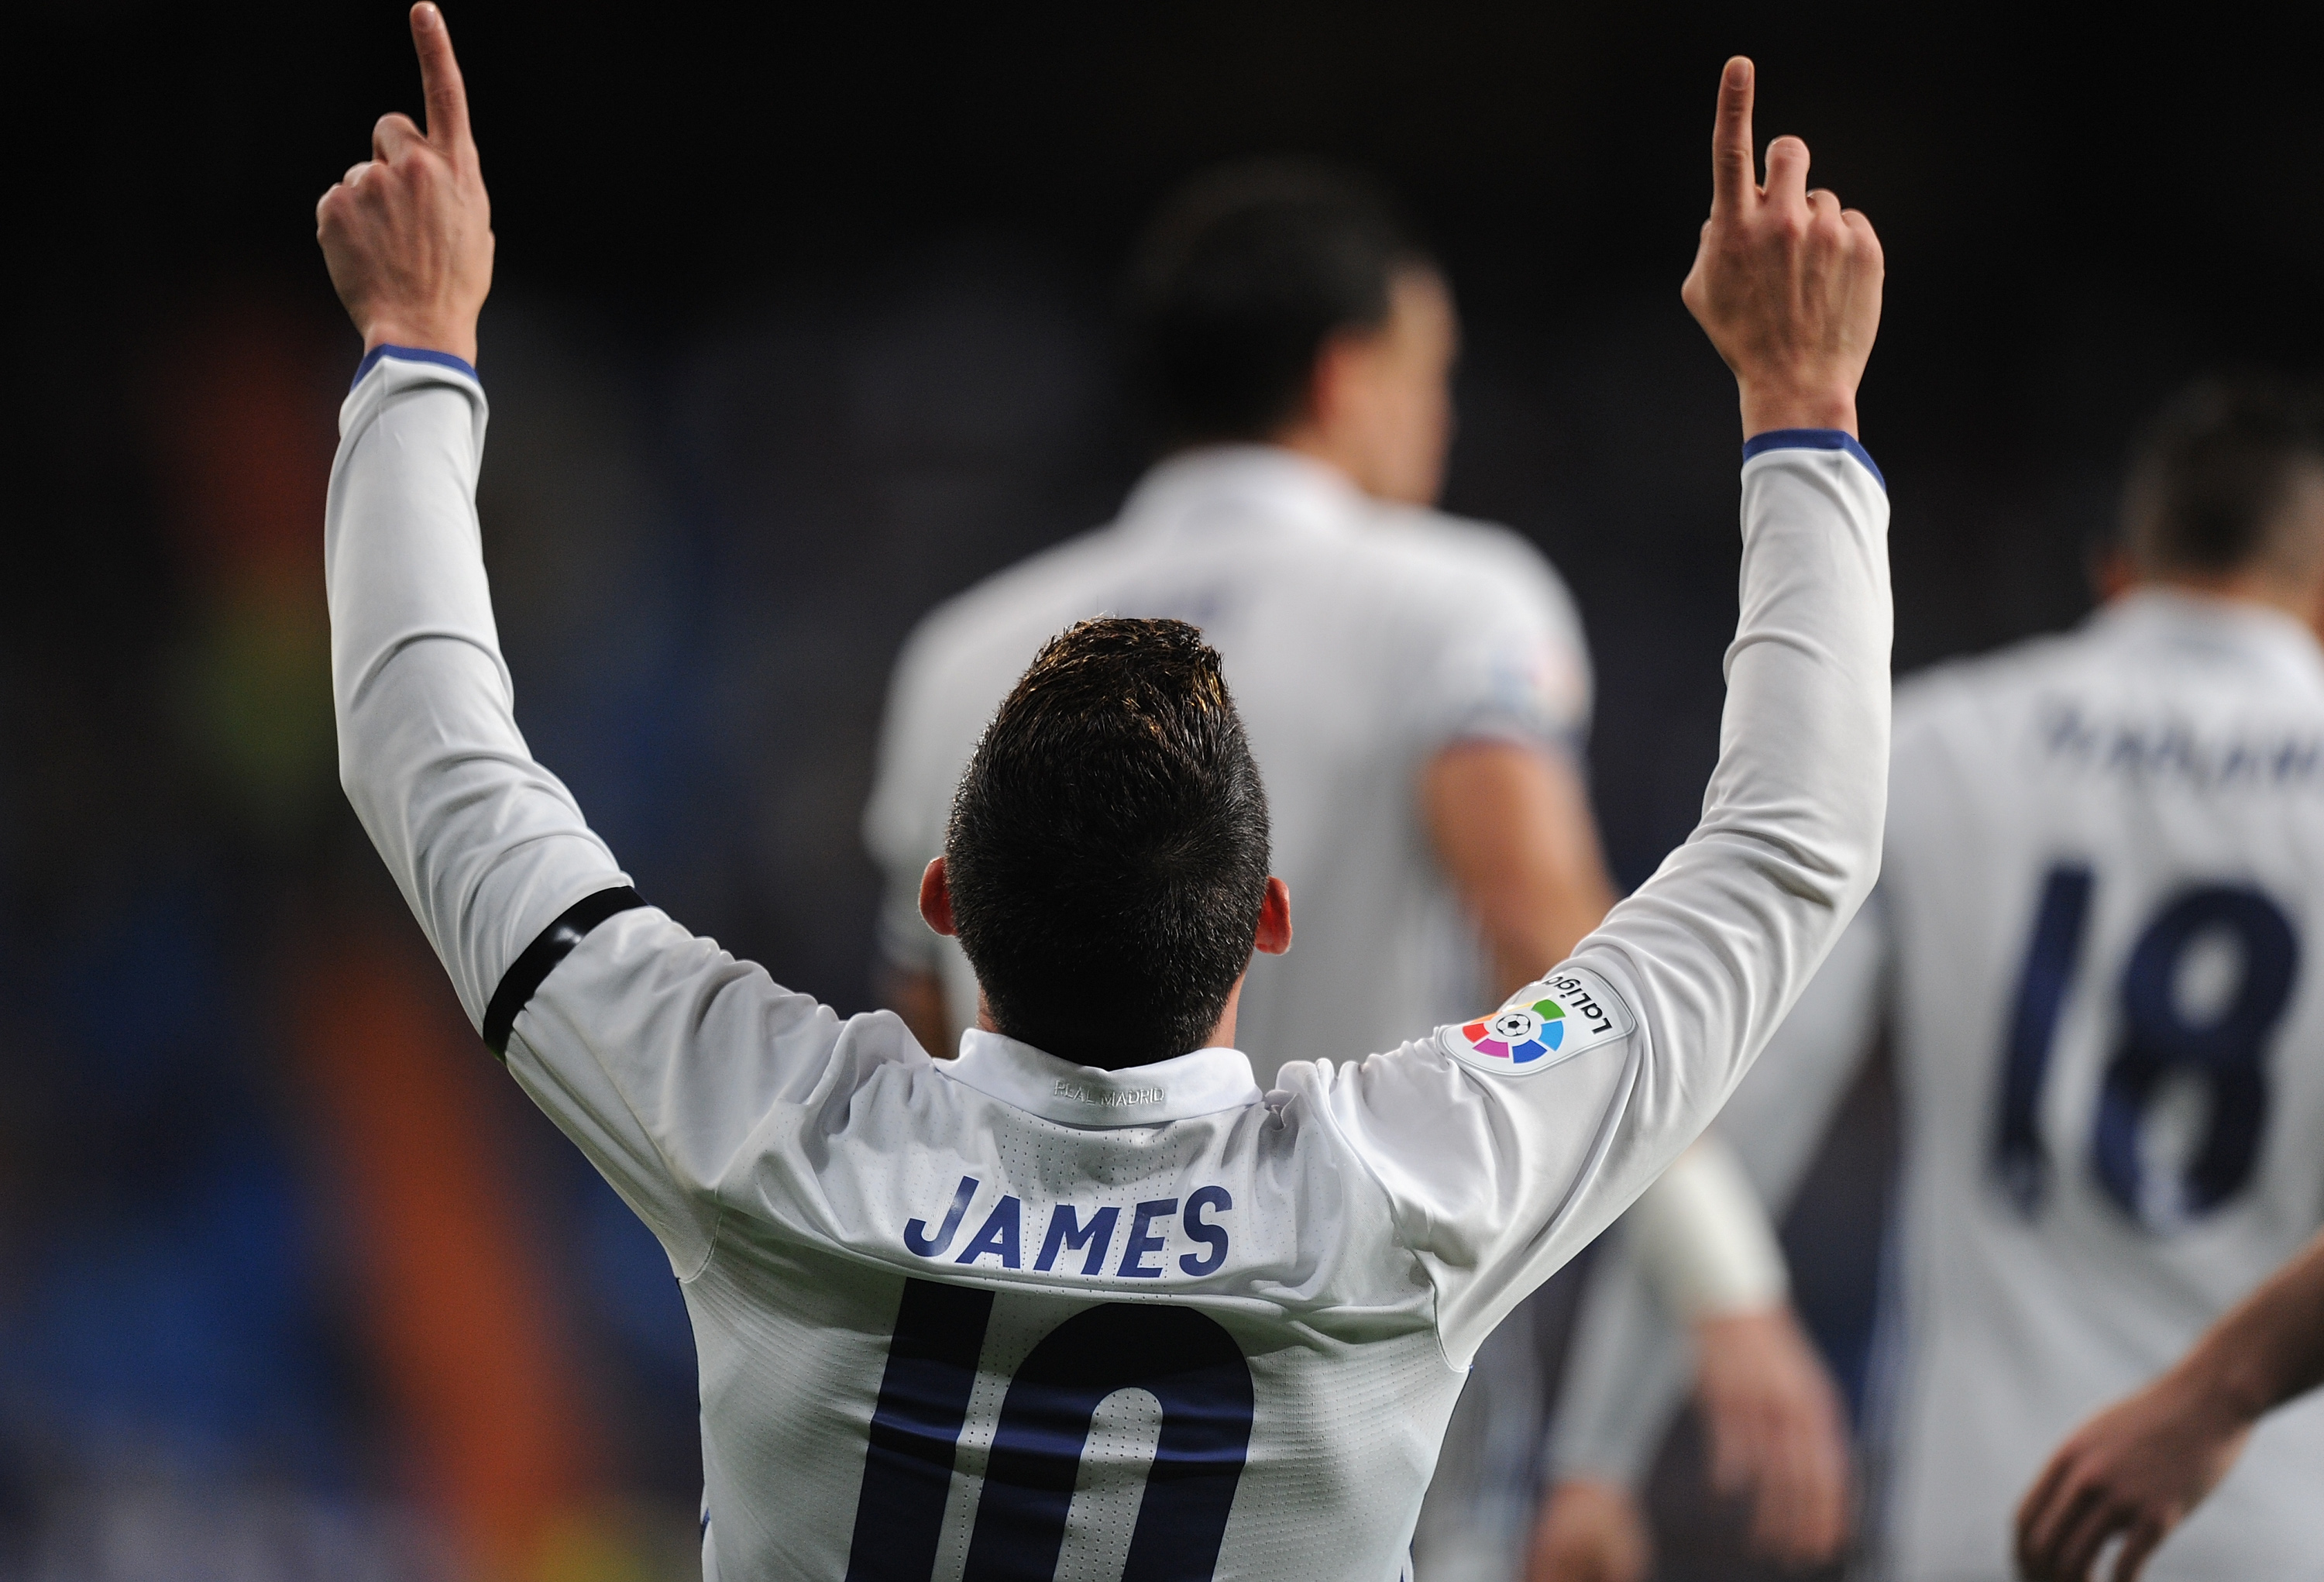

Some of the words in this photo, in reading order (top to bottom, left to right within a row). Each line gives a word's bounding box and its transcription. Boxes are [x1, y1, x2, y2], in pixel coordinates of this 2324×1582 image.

[1054, 1080, 1095, 1106] REAL
[1100, 1087, 1165, 1107] MADRID
[1989, 865, 2298, 1228] 18
[903, 1175, 1232, 1278] JAMES
[844, 1277, 1254, 1582] 10
